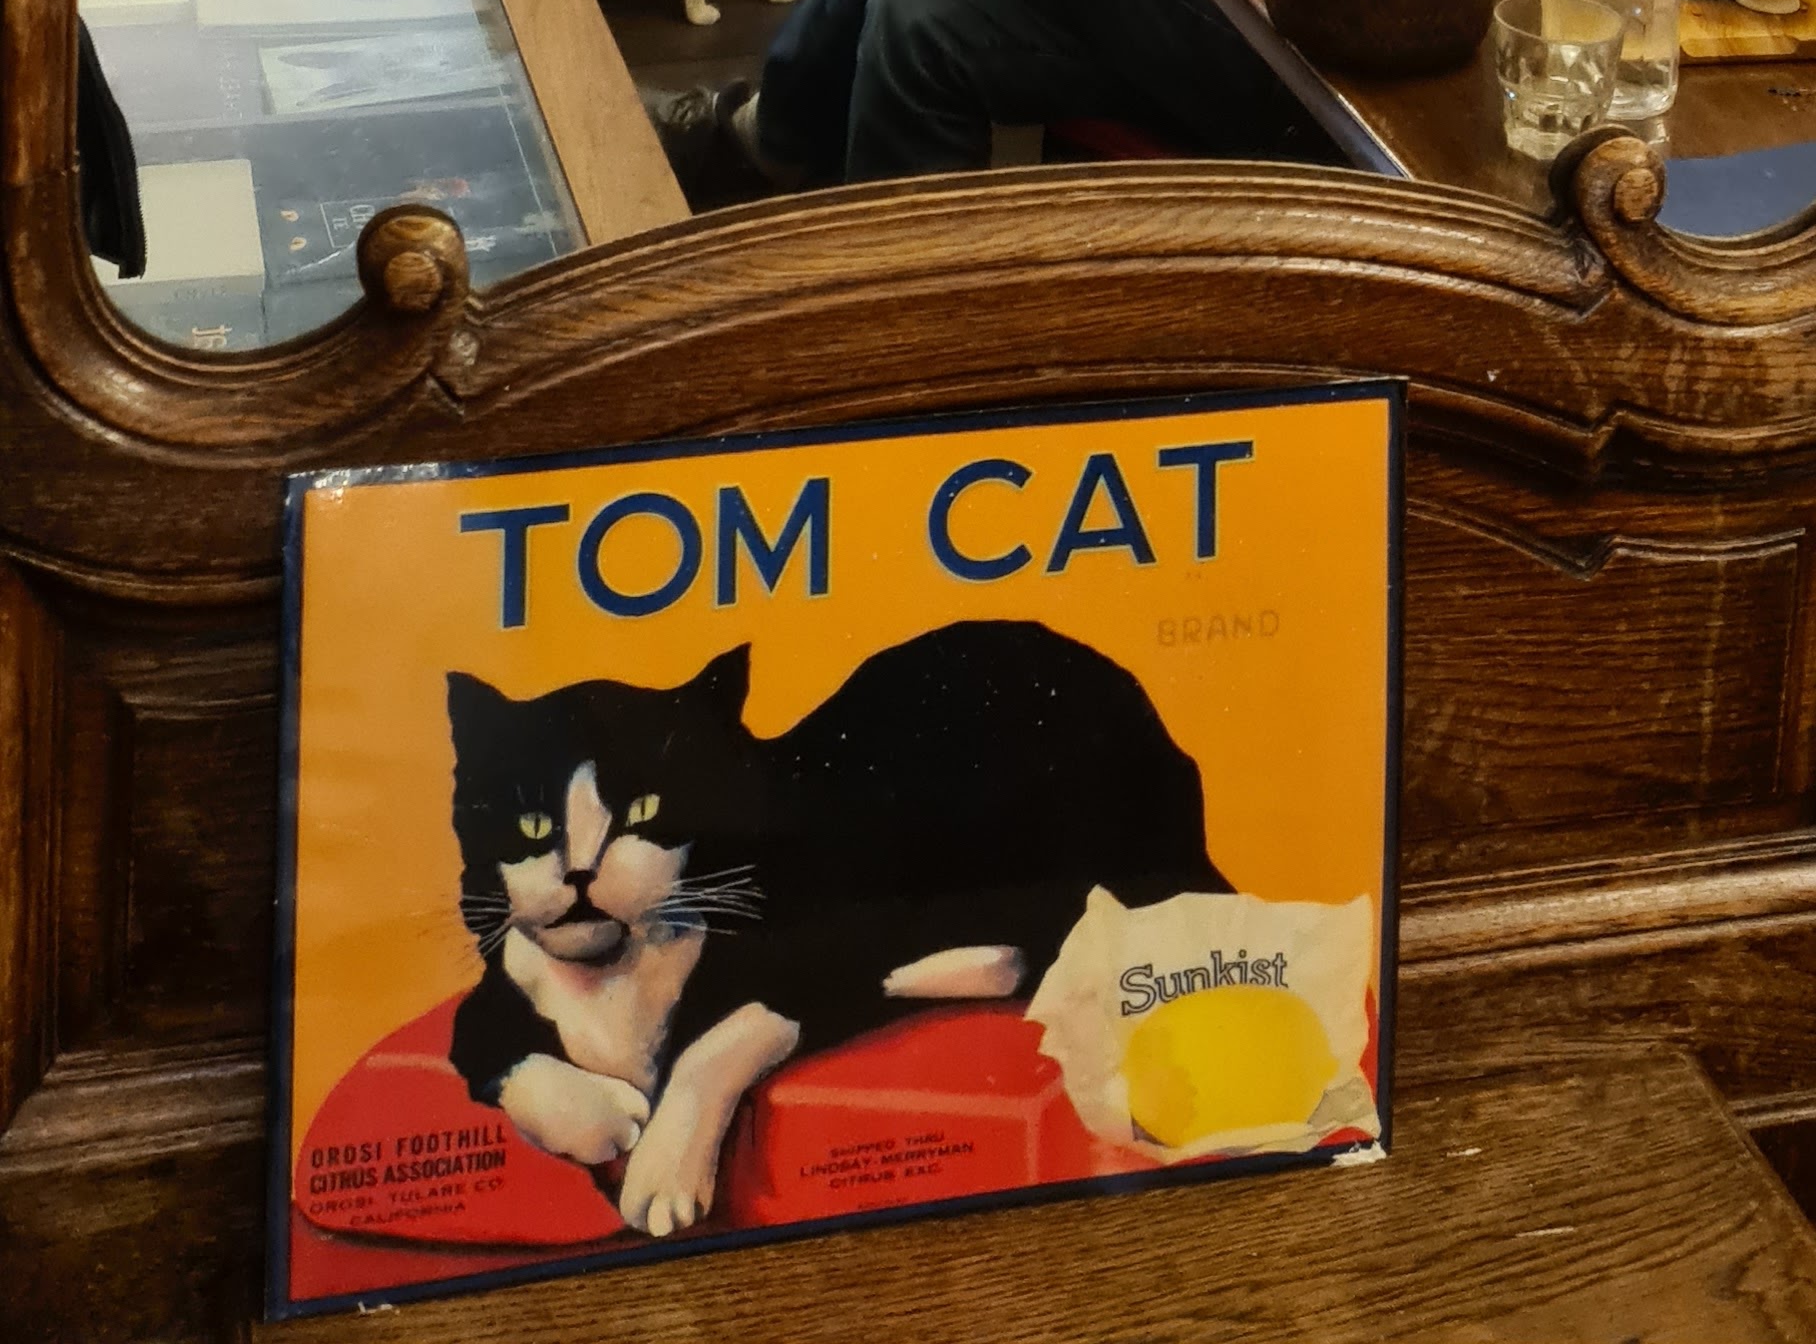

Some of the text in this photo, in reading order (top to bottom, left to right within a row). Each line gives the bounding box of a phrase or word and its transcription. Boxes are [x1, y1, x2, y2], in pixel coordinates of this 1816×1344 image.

[459, 439, 1255, 630] TOM CAT
[1156, 609, 1280, 647] BRAND
[1119, 949, 1289, 1016] Sunkist
[311, 1124, 508, 1169] OROSI FOOTHILL
[829, 1131, 946, 1159] SHIPPED THRU
[309, 1149, 506, 1195] CITRUS ASSOCIATION
[828, 1170, 896, 1191] CITRUS
[309, 1196, 375, 1216] OROSI
[389, 1183, 466, 1204] TULARE
[349, 1202, 467, 1226] CALIFORNIA
